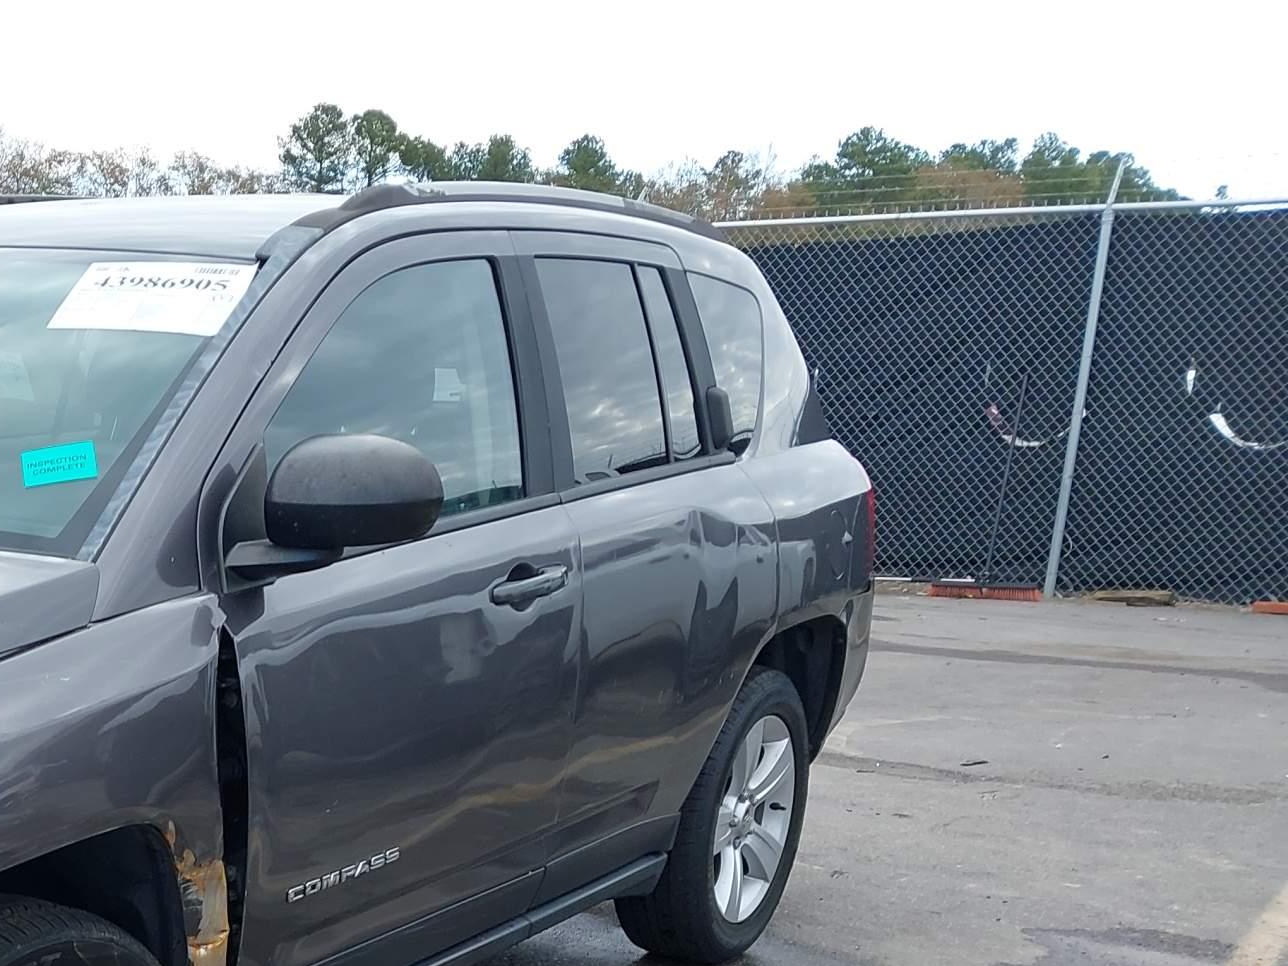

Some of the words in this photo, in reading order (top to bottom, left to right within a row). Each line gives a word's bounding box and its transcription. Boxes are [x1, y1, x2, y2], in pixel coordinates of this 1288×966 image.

[93, 275, 231, 292] 43986905
[26, 453, 87, 471] INSPECTION
[32, 462, 86, 476] COMPLETE
[287, 847, 400, 903] COMPASS
